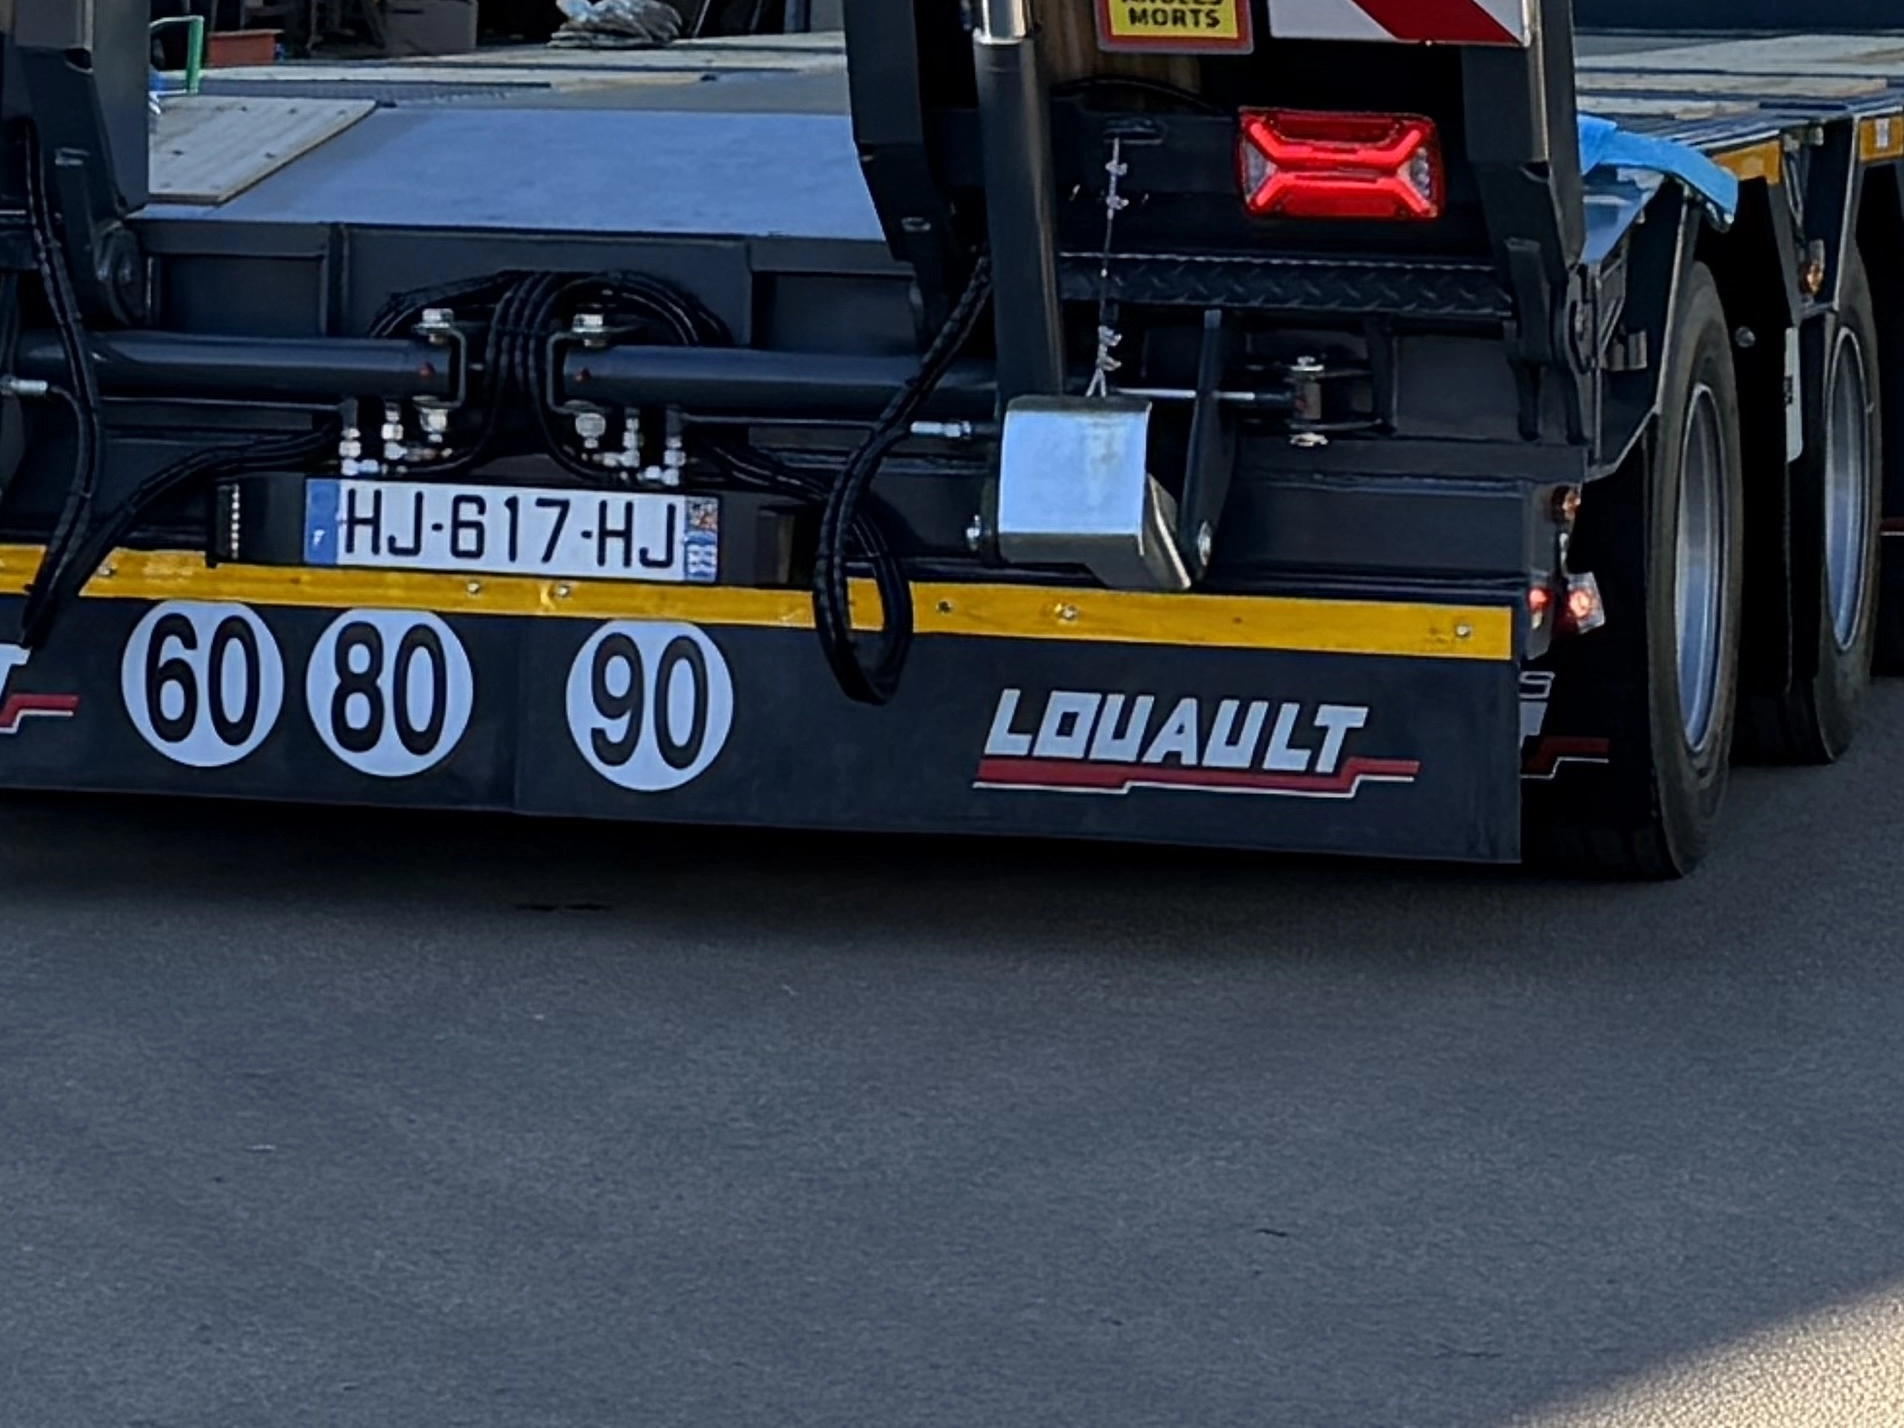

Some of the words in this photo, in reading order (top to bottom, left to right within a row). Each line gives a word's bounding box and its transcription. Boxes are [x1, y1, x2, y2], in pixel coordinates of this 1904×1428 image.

[1128, 7, 1221, 28] MORTS
[344, 488, 677, 570] HJ-617-HJ
[145, 613, 260, 746] 60
[330, 620, 448, 756] 80
[590, 632, 709, 771] 90
[983, 688, 1370, 774] LOUAULT
